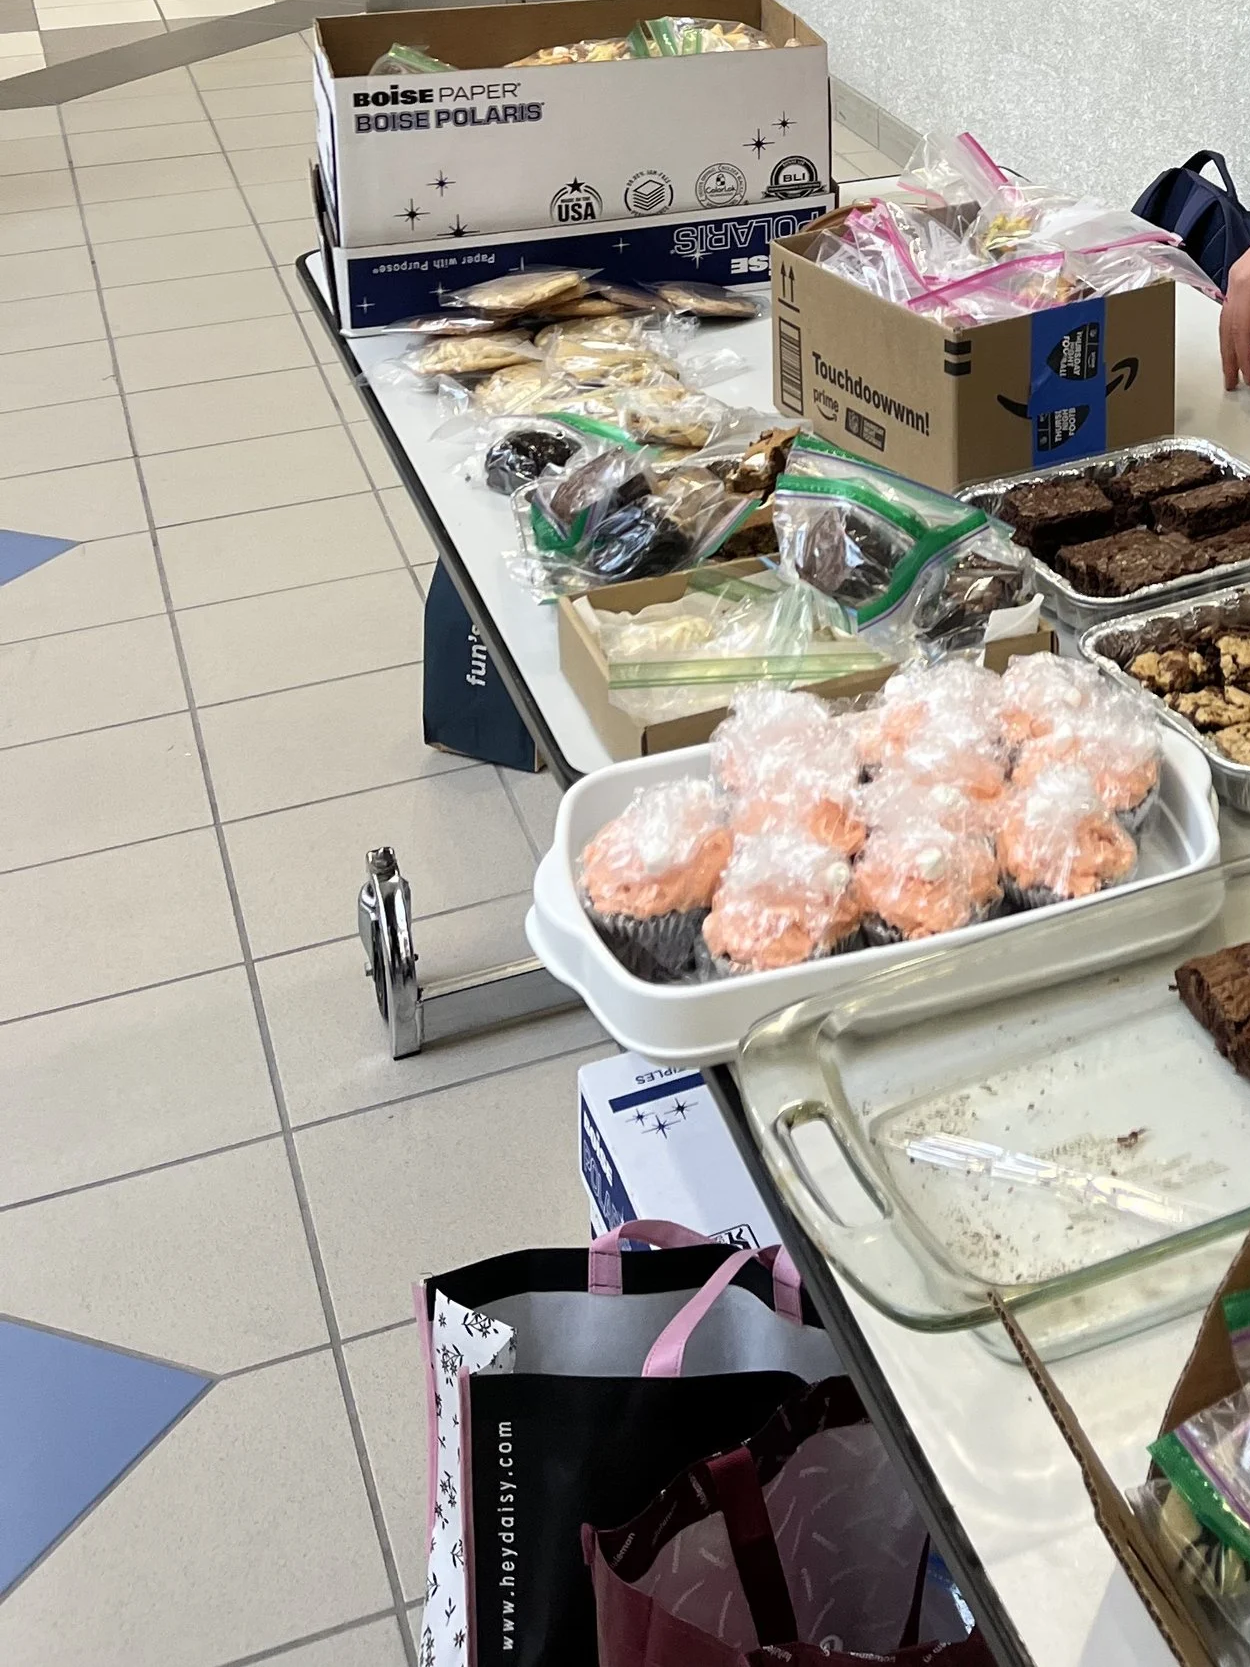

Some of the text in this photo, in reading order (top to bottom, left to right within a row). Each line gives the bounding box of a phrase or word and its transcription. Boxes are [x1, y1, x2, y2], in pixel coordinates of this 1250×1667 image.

[354, 103, 543, 133] BOISE POLARIS
[783, 173, 805, 182] BLI
[557, 202, 596, 222] USA
[433, 257, 458, 268] with
[461, 253, 496, 265] Paper
[812, 351, 930, 437] Touchdoowwnn!
[813, 388, 839, 413] prime
[497, 1421, 518, 1650] www.heydaisy.com
